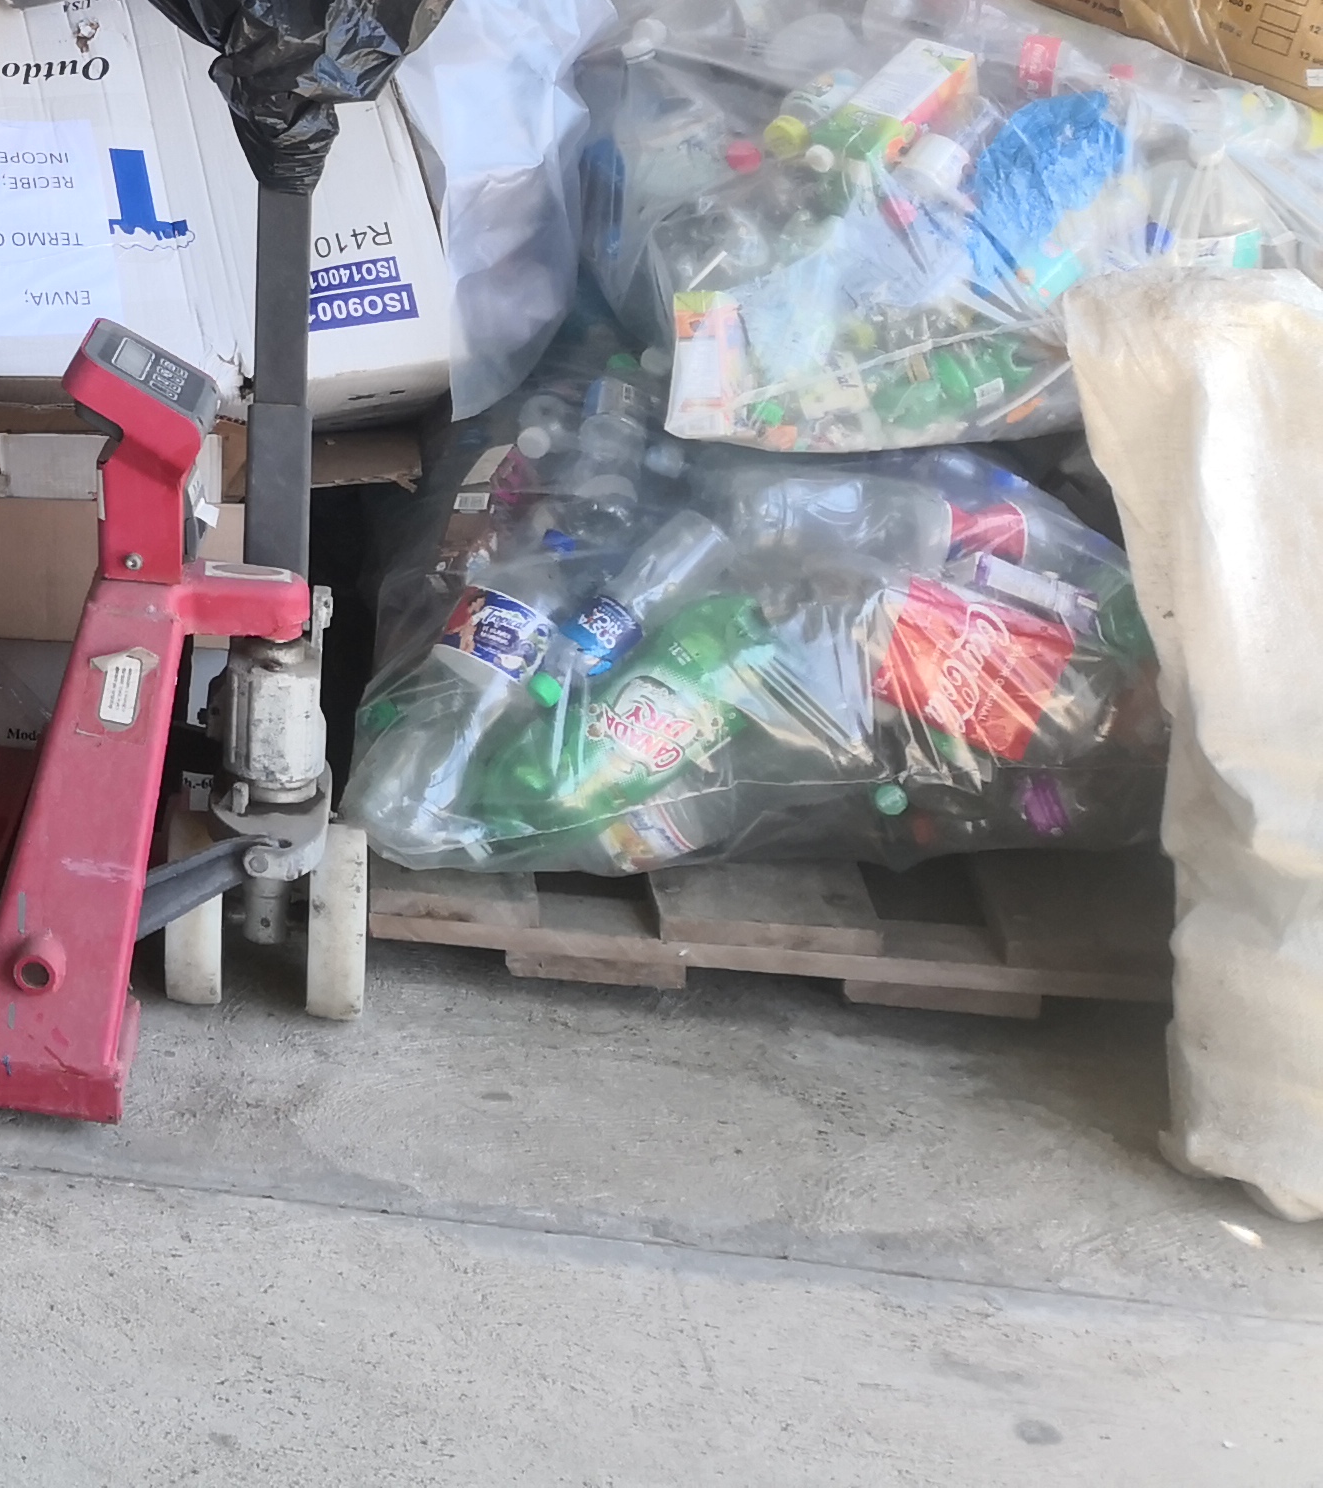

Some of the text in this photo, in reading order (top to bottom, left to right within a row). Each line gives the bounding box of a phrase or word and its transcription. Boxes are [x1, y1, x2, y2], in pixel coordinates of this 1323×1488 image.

[12, 231, 83, 247] TERMO
[314, 221, 393, 258] R410
[483, 608, 531, 633] Tropical
[578, 613, 616, 649] COSTA
[593, 608, 623, 635] RICA
[626, 702, 693, 739] DRY
[605, 713, 682, 769] CANADA
